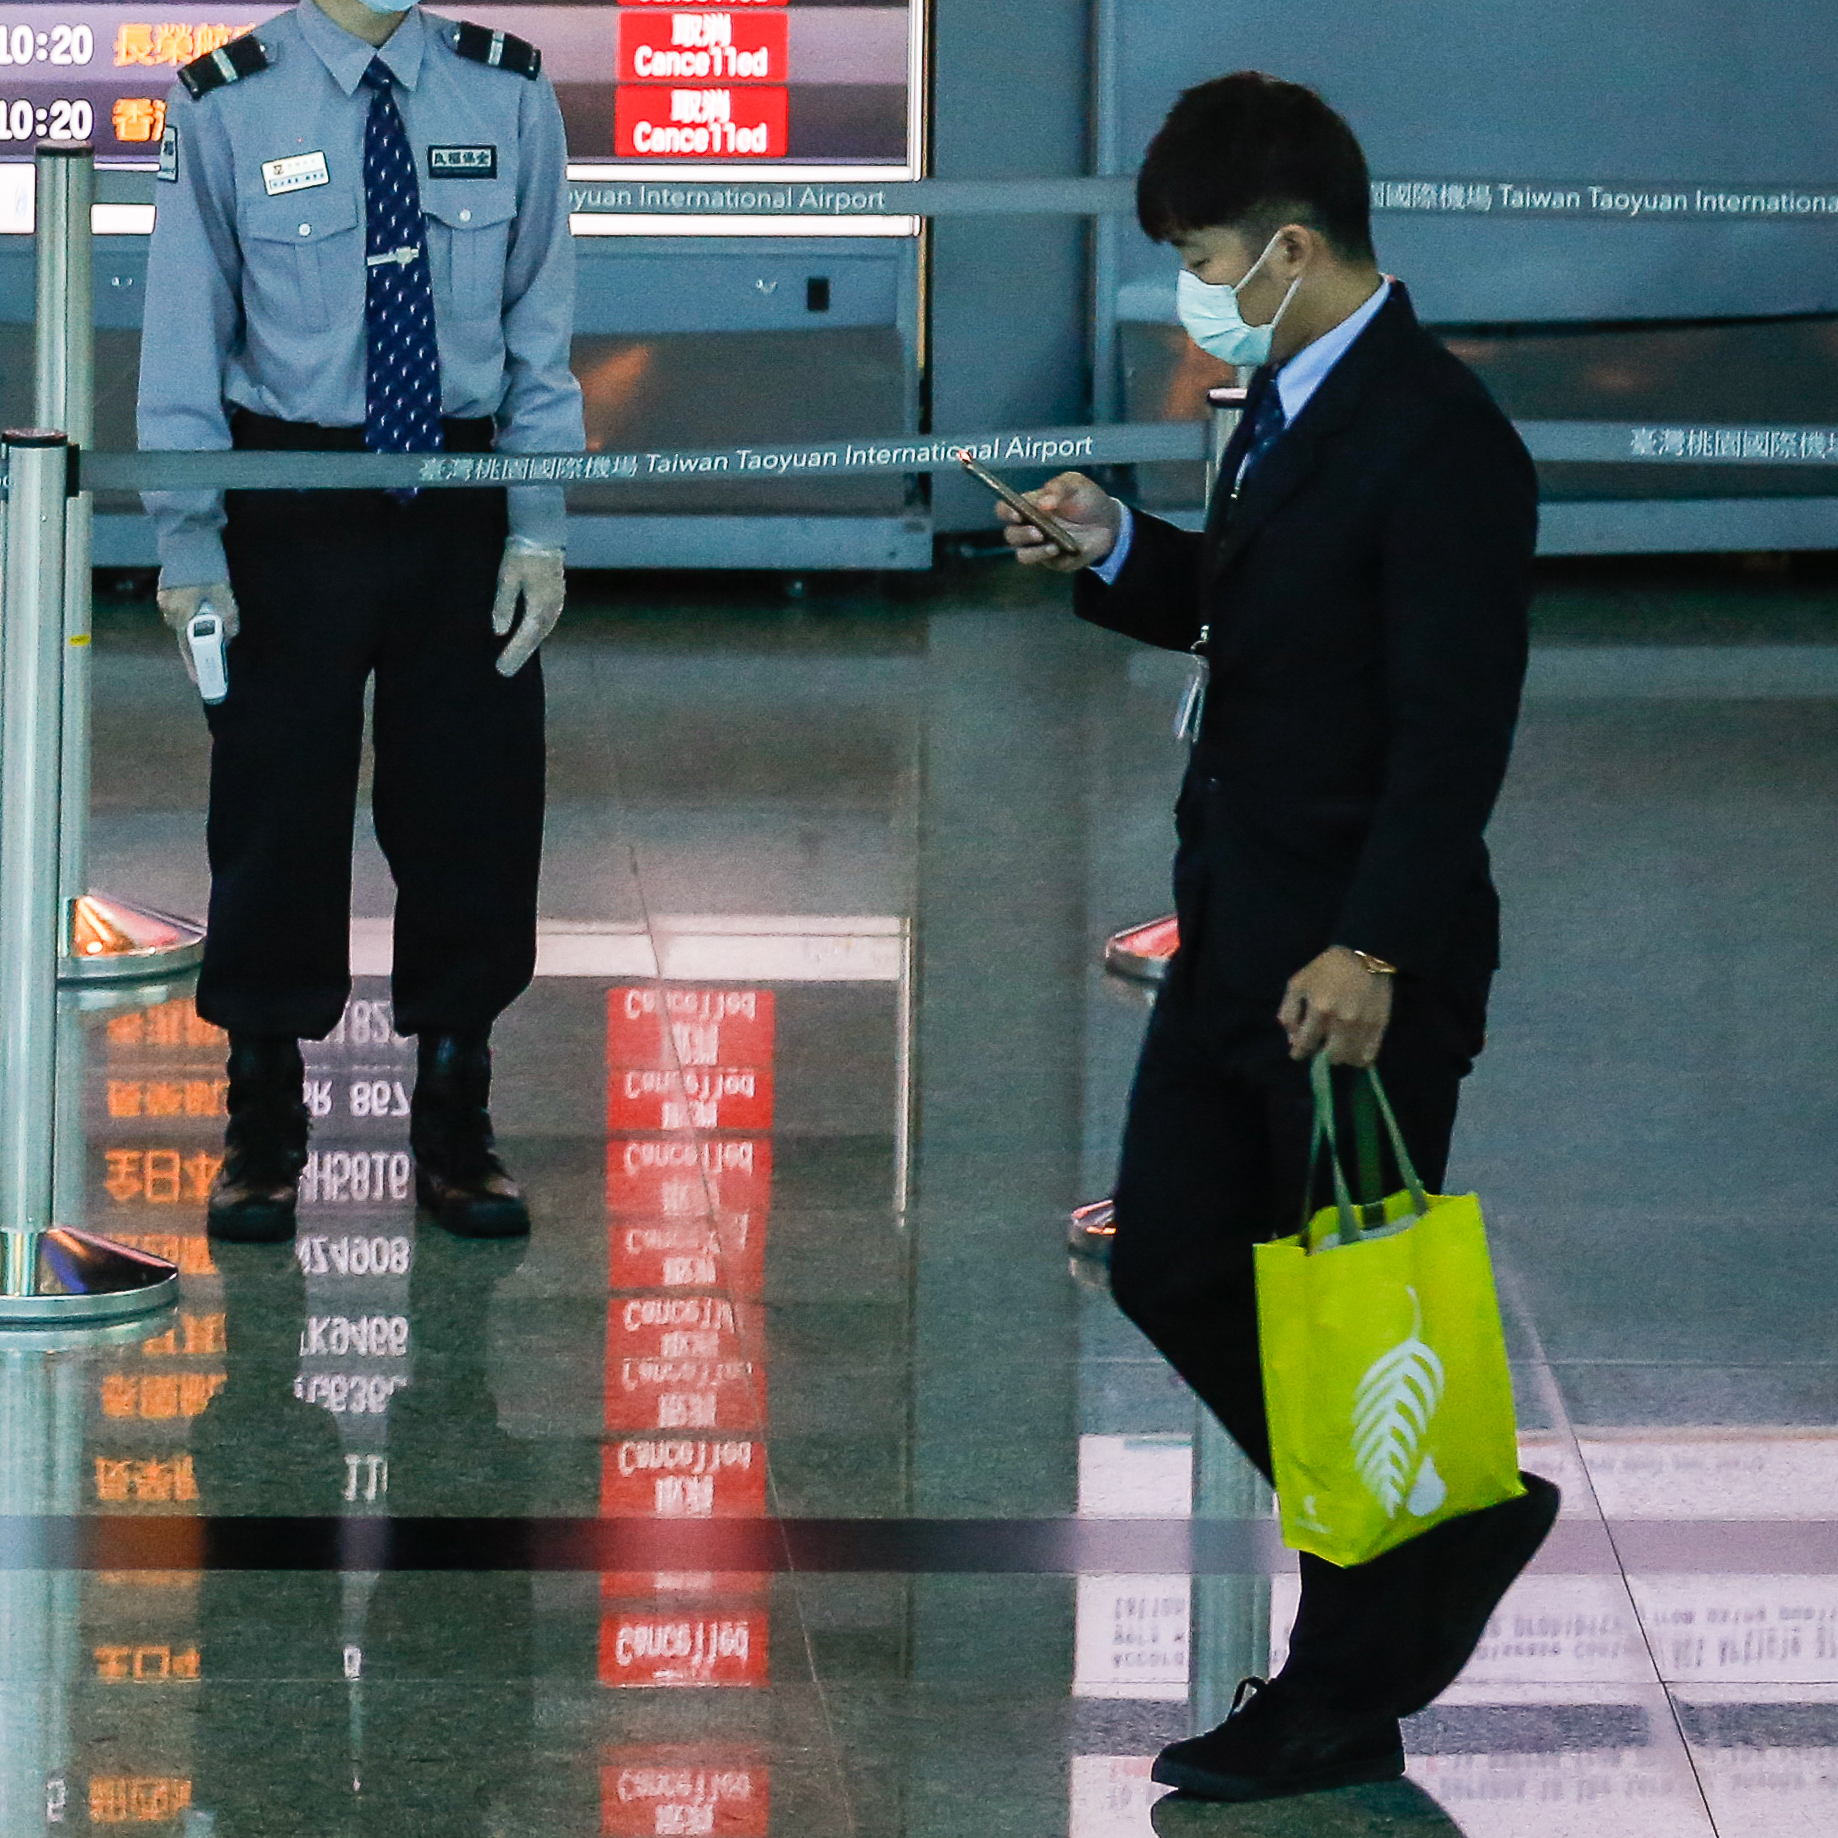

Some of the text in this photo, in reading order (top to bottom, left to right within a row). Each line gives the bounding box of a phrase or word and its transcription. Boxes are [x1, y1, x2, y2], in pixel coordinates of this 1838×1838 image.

[634, 45, 770, 78] Cancelled
[634, 121, 769, 154] Cancelled
[568, 186, 886, 215] yuan International Airport
[1498, 183, 1582, 210] Taiwan
[1587, 185, 1688, 217] Taoyuan
[646, 433, 1094, 475] Taiwan Taoyuan International Airport
